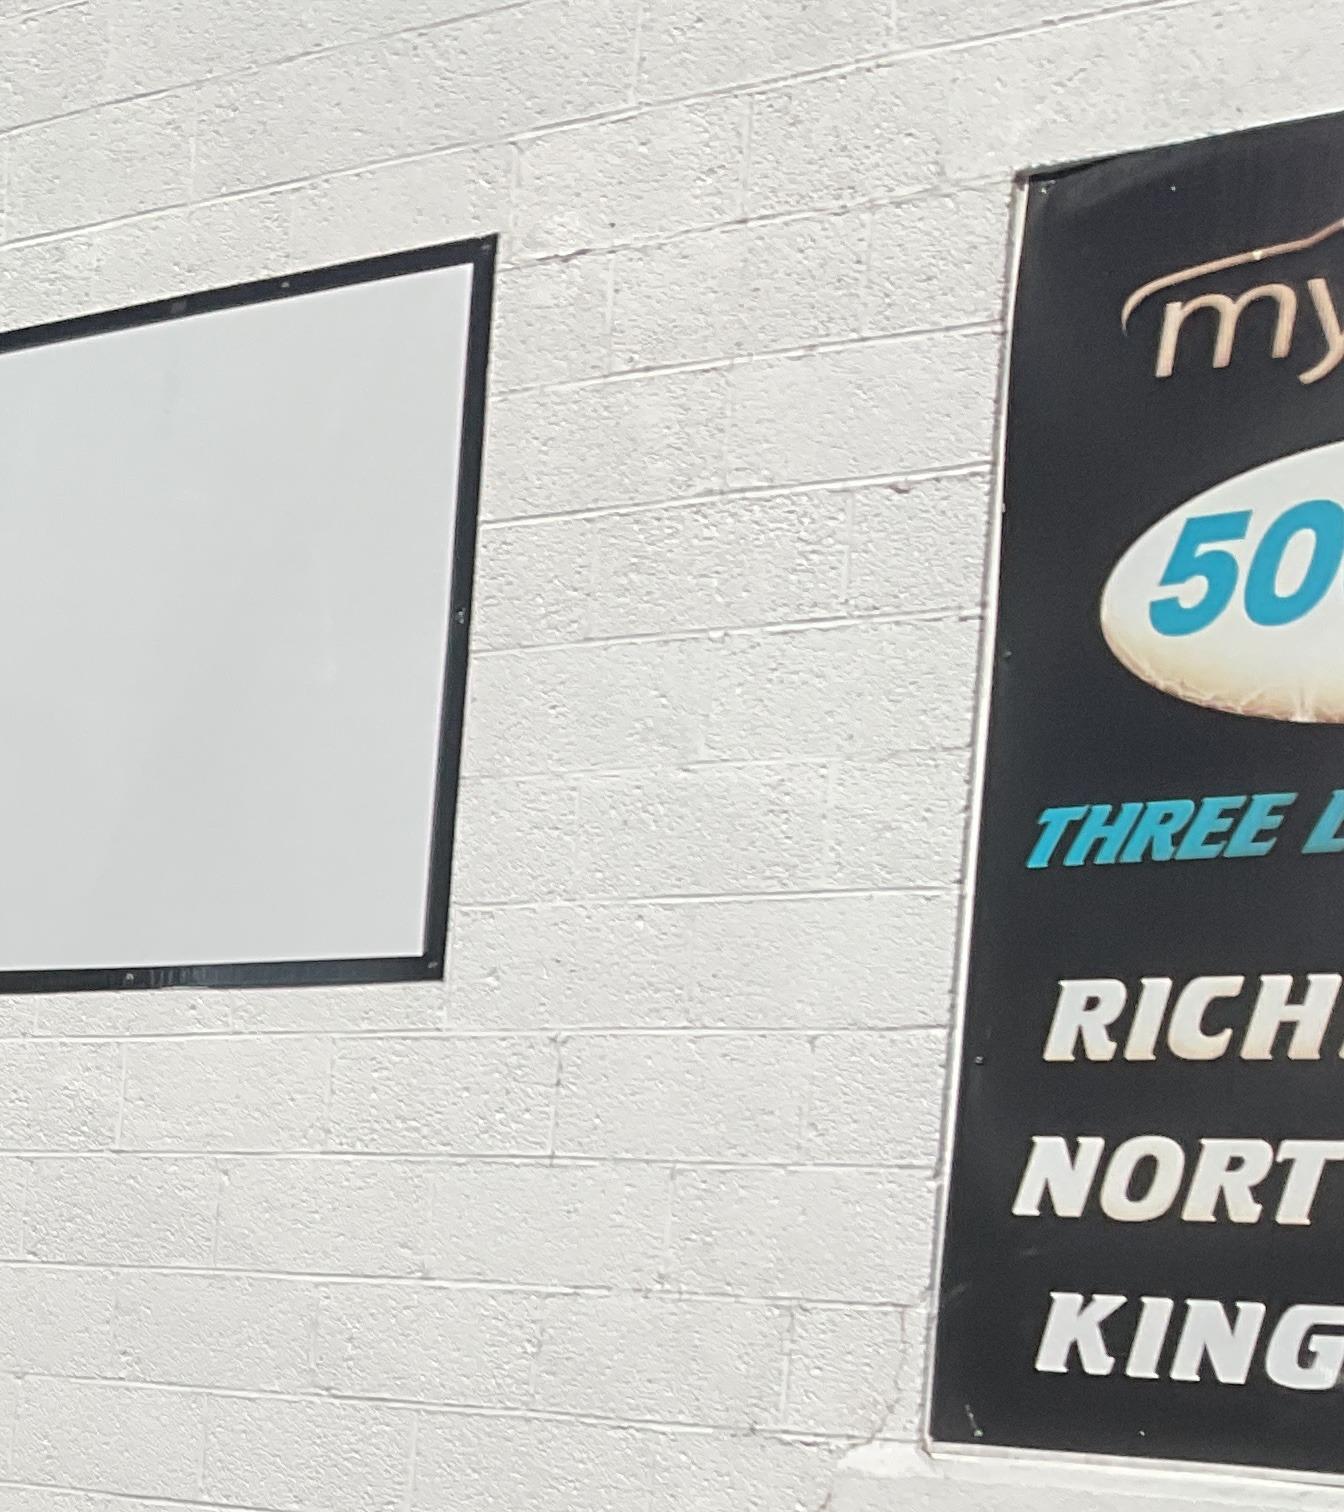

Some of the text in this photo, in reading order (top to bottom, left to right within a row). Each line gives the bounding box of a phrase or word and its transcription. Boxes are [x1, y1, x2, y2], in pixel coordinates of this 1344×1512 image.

[1149, 500, 1344, 636] 50
[1025, 792, 1297, 869] THREE
[1042, 973, 1344, 1062] RICH
[1034, 1291, 1344, 1391] KING
